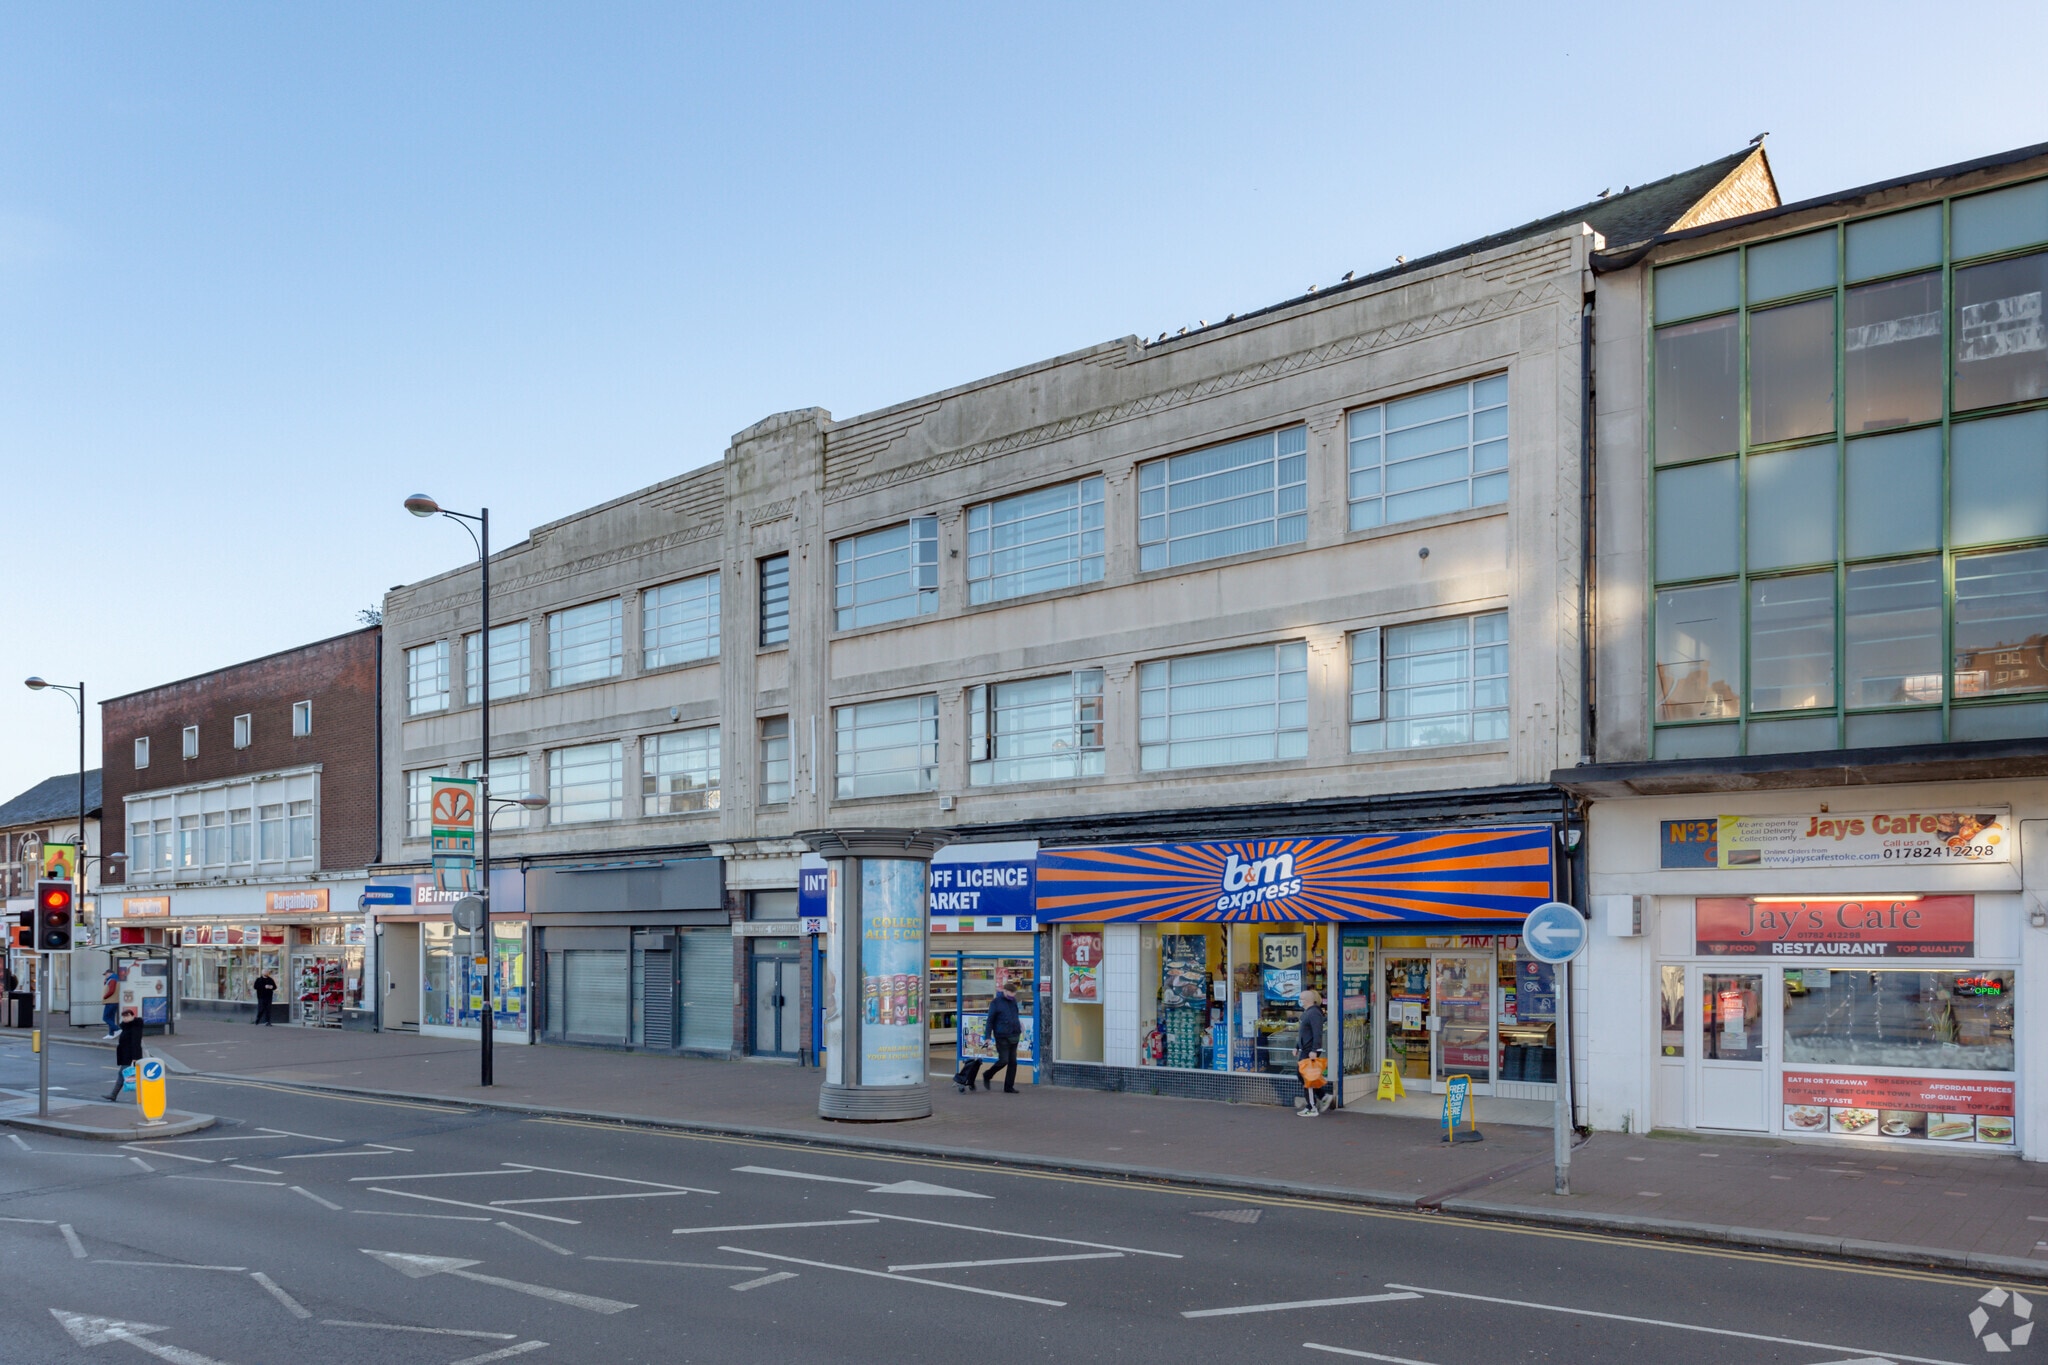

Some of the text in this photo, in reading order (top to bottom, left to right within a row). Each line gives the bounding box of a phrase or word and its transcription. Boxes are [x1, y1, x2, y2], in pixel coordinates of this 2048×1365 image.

[1736, 821, 1749, 829] We
[1766, 821, 1785, 829] open
[1805, 813, 1939, 841] Jays Cafe
[1764, 827, 1796, 836] Delivery
[1739, 835, 1778, 843] Collection
[1780, 834, 1797, 843] only
[1883, 839, 1901, 847] Call
[1883, 845, 1994, 859] 01782412298
[1764, 852, 1880, 864] www.jayscafestoke.com
[957, 867, 1028, 888] LICENCE
[1216, 879, 1301, 911] express
[273, 891, 319, 911] BargainBuys
[1740, 901, 1922, 940] Jay's Cafe
[866, 929, 890, 940] ALL
[1827, 931, 1861, 939] 412298
[1709, 944, 1756, 952] TOP FOOD
[1772, 942, 1887, 955] RESTAURANT
[1896, 945, 1966, 954] TOP QUALITY
[1075, 945, 1090, 962] £1
[1265, 944, 1299, 963] £1.50
[1974, 987, 2000, 995] OPEN
[1463, 1053, 1482, 1062] Best
[1825, 1078, 1868, 1086] TAKEAWAY
[1929, 1083, 1982, 1092] AFFORDABLE
[1866, 1101, 1957, 1111] FRIENDLY ATMOSPHERE
